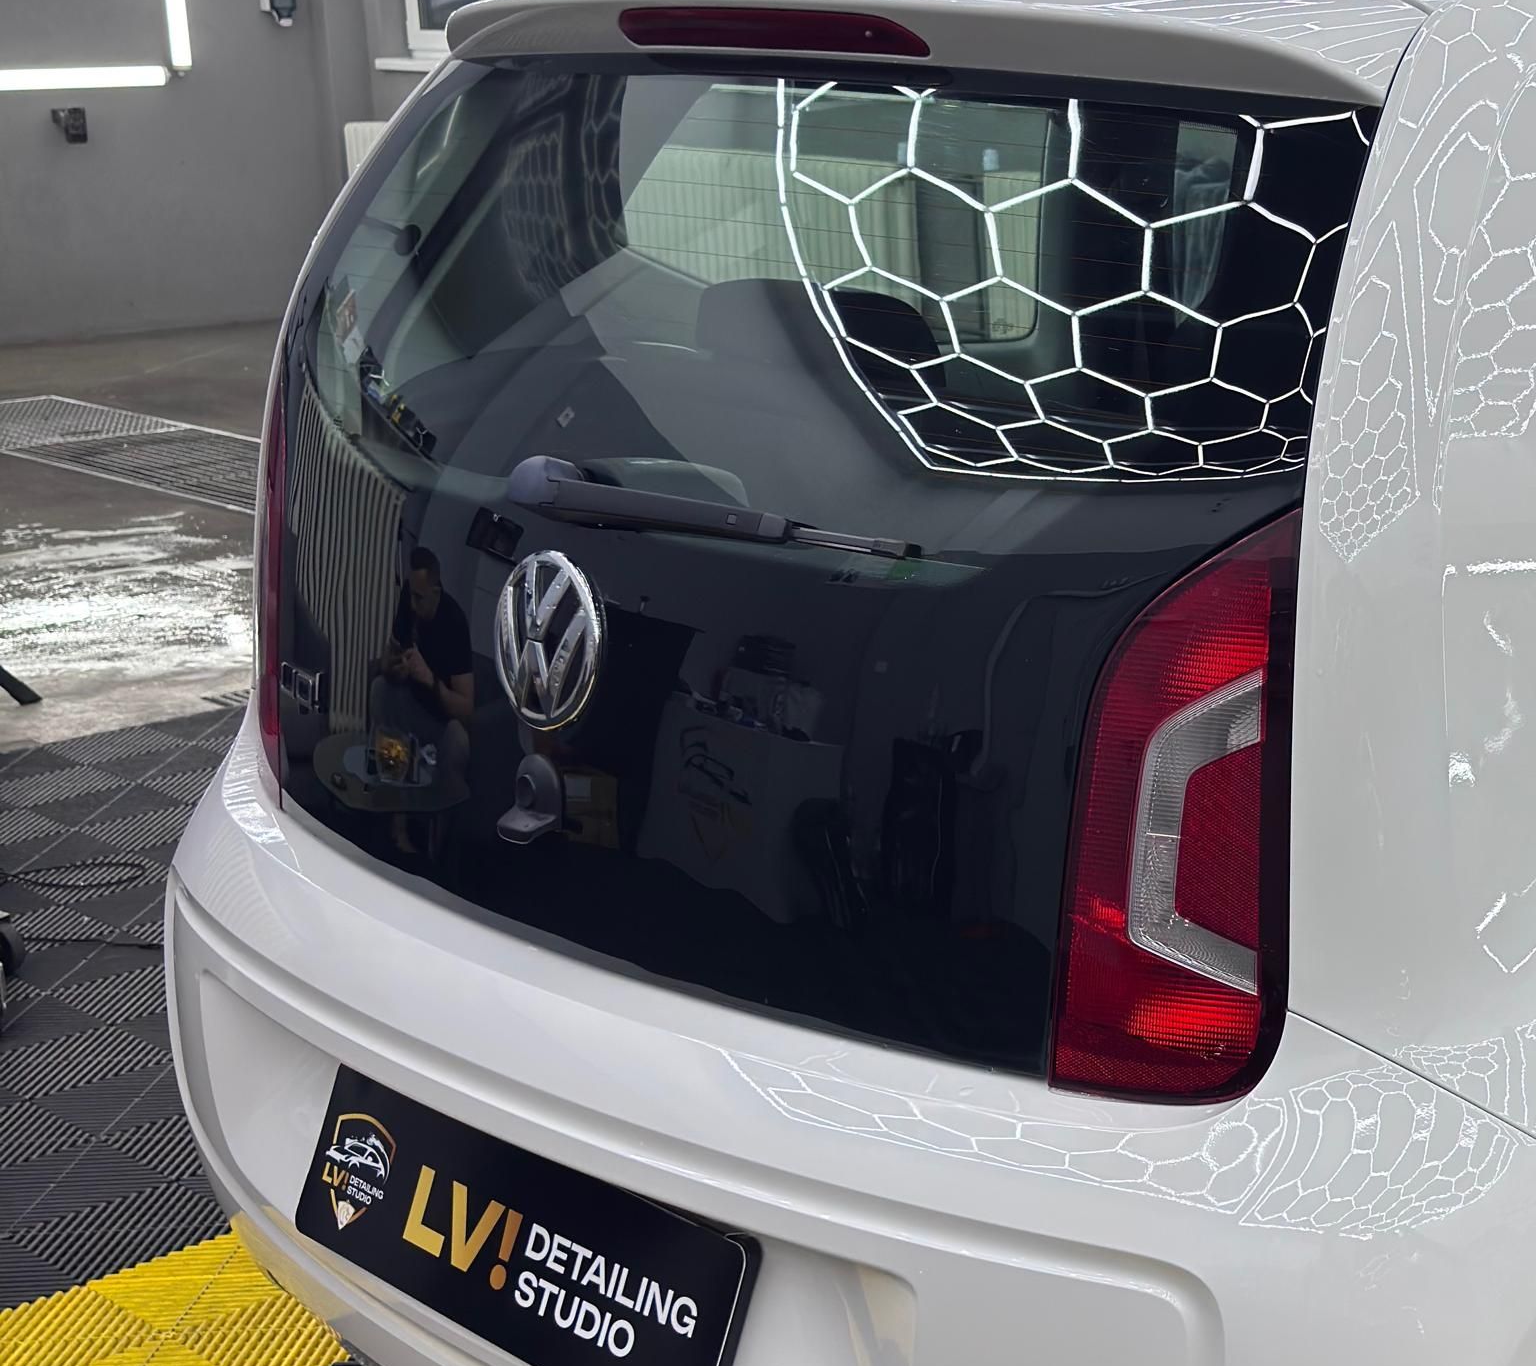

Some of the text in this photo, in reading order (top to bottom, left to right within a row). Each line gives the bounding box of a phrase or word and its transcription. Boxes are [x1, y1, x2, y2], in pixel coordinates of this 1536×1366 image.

[322, 1161, 349, 1191] LV!
[346, 1186, 372, 1205] STUDIO
[349, 1175, 384, 1200] DETAILING
[403, 1165, 523, 1291] LV!
[524, 1223, 698, 1338] DETAILING
[514, 1272, 635, 1357] STUDIO
